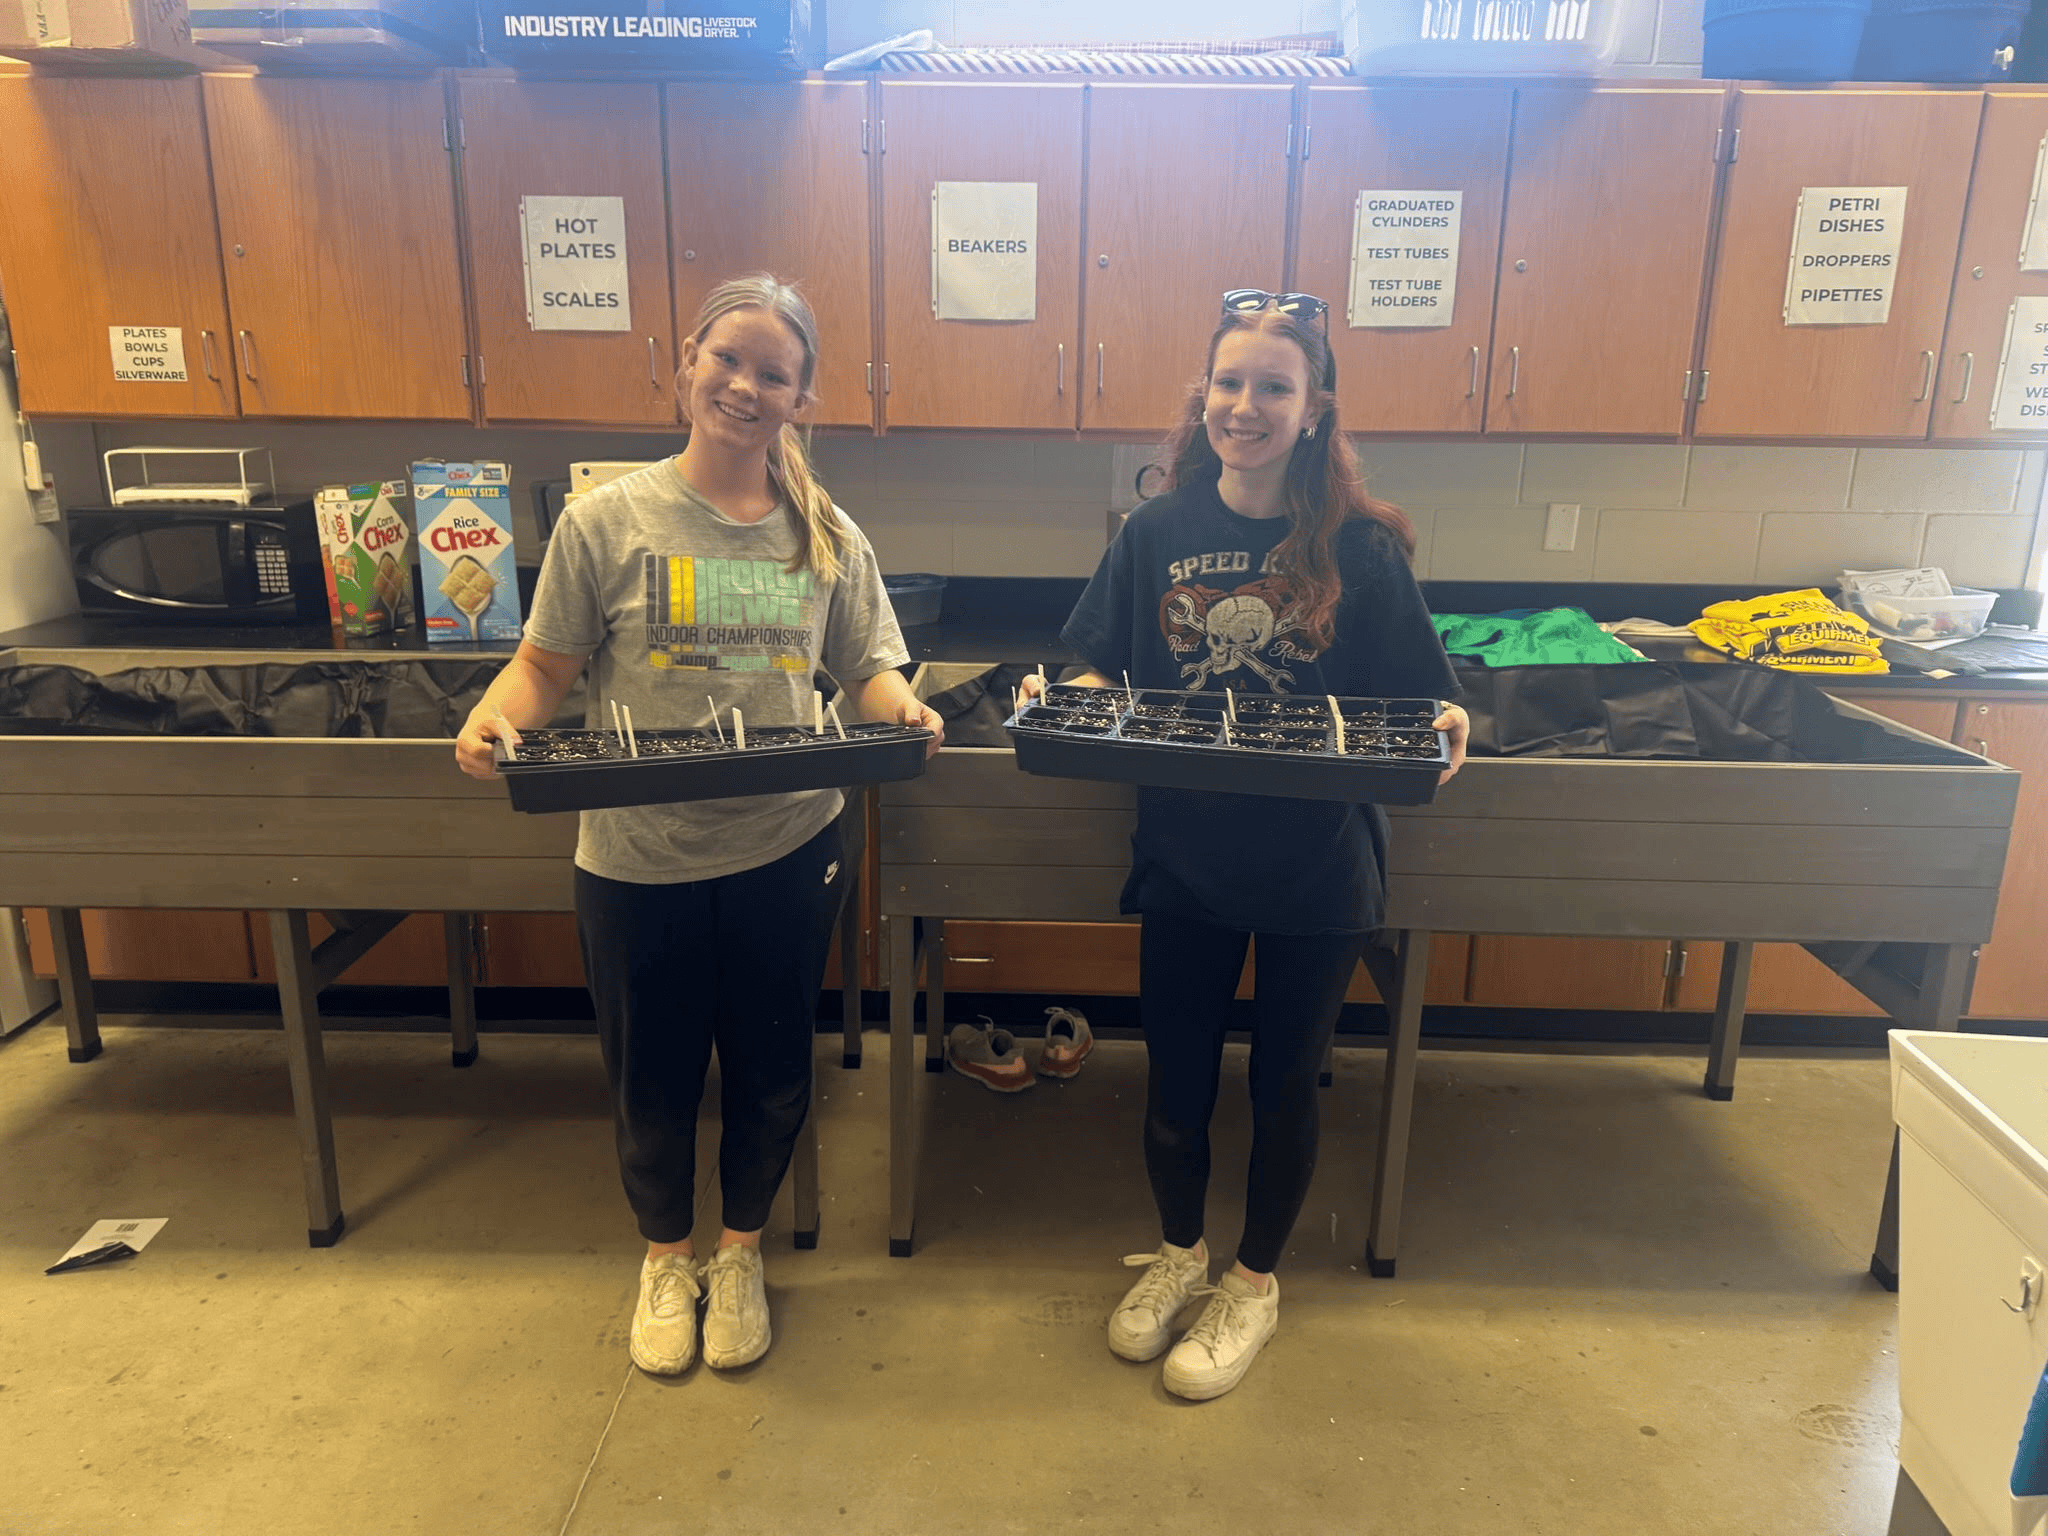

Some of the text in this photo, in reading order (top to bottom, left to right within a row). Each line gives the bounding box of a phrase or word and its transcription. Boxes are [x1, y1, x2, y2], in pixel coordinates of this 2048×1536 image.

[504, 15, 703, 38] INDUSTRY LEADING
[703, 17, 758, 28] LIVESTOCK
[1368, 199, 1455, 211] GRADUATED
[1829, 197, 1880, 211] PETRI
[555, 218, 598, 234] HOT
[1372, 216, 1449, 228] CYLINDERS
[1819, 219, 1885, 233] DISHES
[540, 242, 616, 259] PLATES
[948, 239, 1028, 253] BEAKERS
[1367, 247, 1449, 259] TEST TUBES
[1802, 254, 1892, 267] DROPPERS
[1369, 279, 1442, 290] TEST TUBE
[543, 291, 619, 308] SCALES
[1371, 296, 1438, 307] HOLDERS
[1801, 288, 1884, 302] PIPETTES
[123, 328, 167, 338] PLATES
[124, 342, 168, 352] BOWLS
[132, 356, 165, 367] CUPS
[115, 370, 186, 380] SILVERWARE
[2020, 404, 2048, 417] DIS
[444, 487, 500, 497] FAMILY SIZE
[376, 516, 395, 529] Corn
[453, 516, 479, 529] Rice
[363, 523, 405, 552] Chex
[430, 526, 502, 553] Chex
[1168, 551, 1250, 584] SPEED
[646, 626, 813, 647] INDOOR CHAMPIONSHIPS
[1789, 629, 1872, 647] EQUIPMEN
